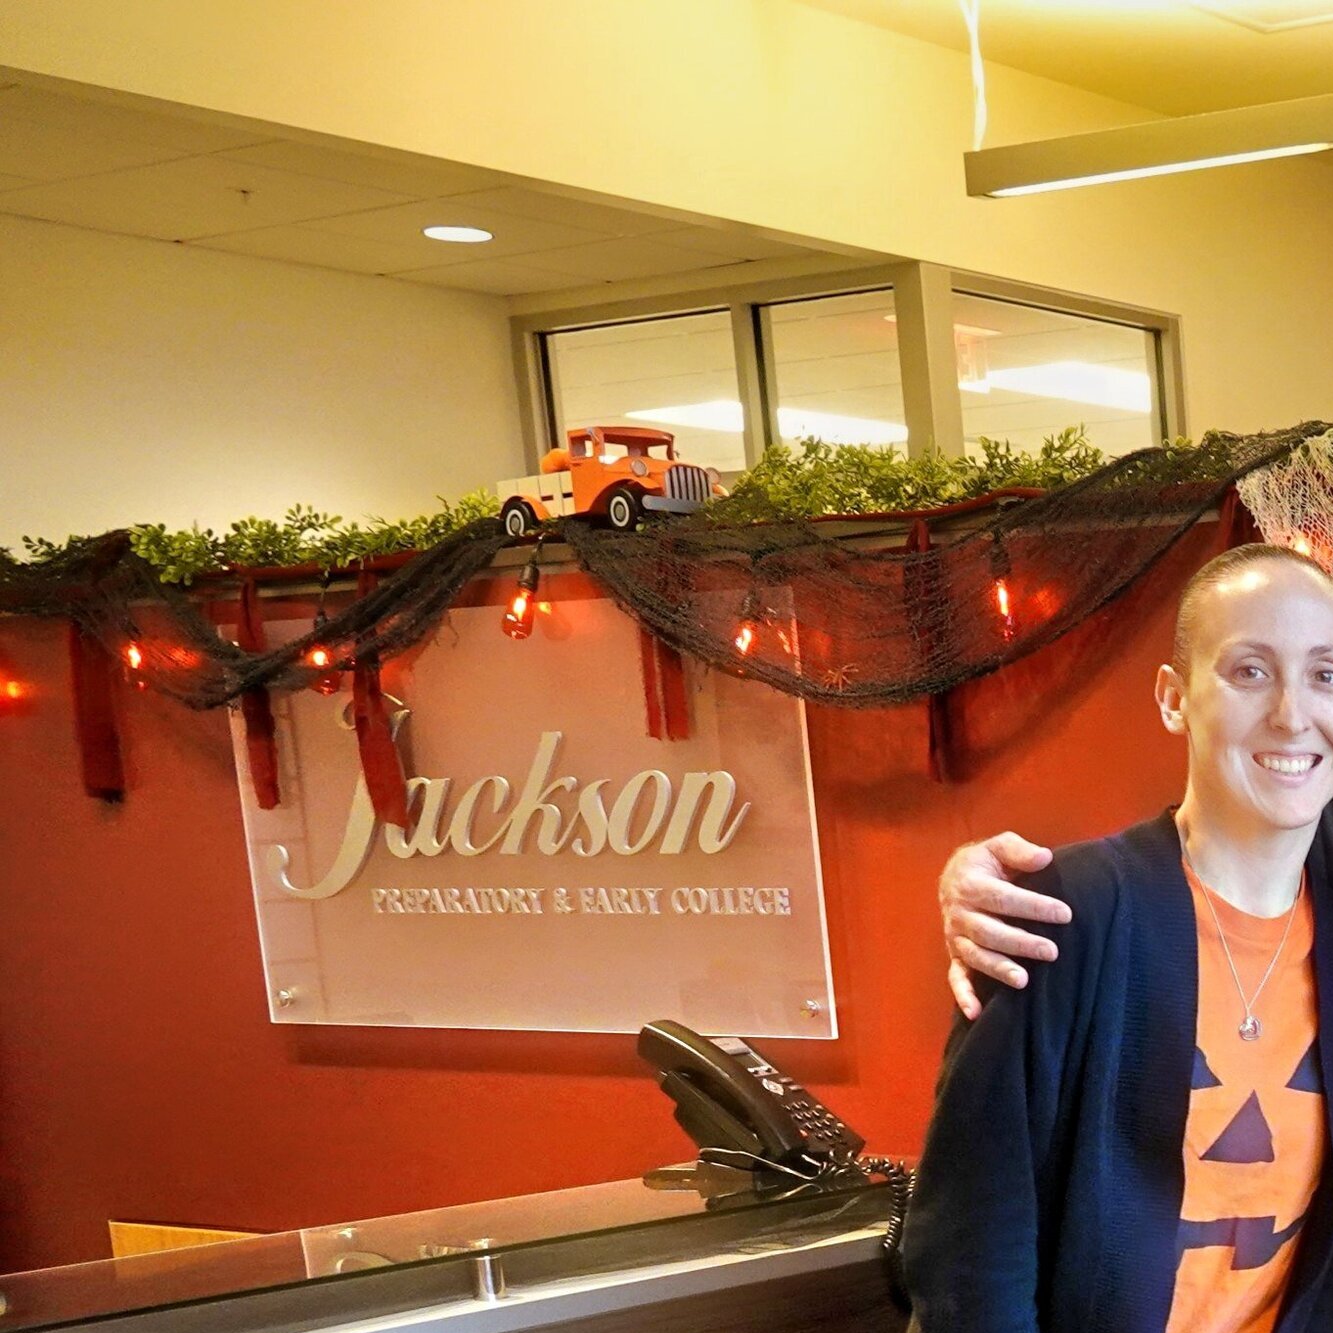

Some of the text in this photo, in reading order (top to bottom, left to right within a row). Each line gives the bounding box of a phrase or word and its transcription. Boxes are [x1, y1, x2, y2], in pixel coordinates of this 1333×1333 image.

[266, 691, 752, 900] Jackson
[372, 887, 792, 915] PREPARATORY & EARLY COLLEGE
